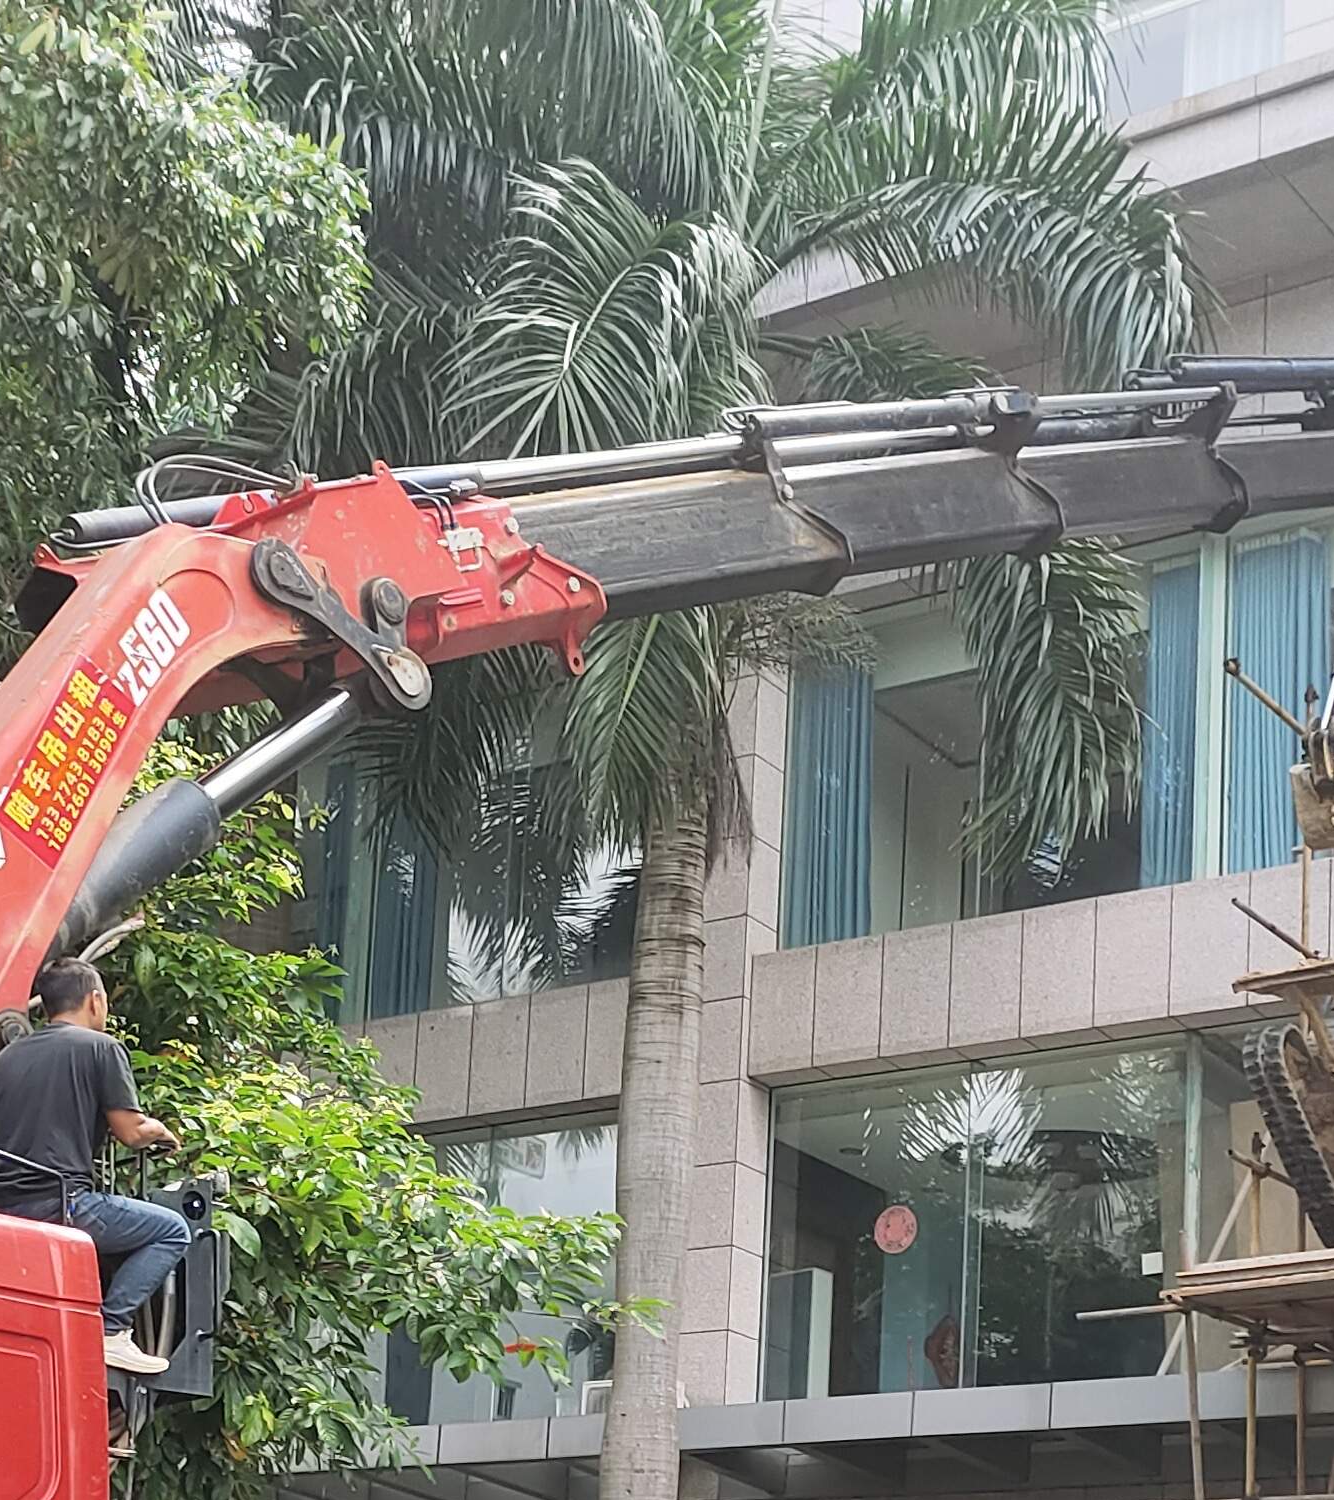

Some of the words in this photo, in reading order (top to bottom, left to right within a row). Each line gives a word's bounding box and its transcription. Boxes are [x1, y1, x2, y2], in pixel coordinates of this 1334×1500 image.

[4, 670, 100, 831] 随车吊出租
[36, 806, 59, 839] 133
[53, 761, 83, 804] 7743
[77, 716, 106, 761] 8183
[48, 817, 72, 850] 188
[66, 772, 95, 819] 2601
[88, 728, 117, 773] 3090
